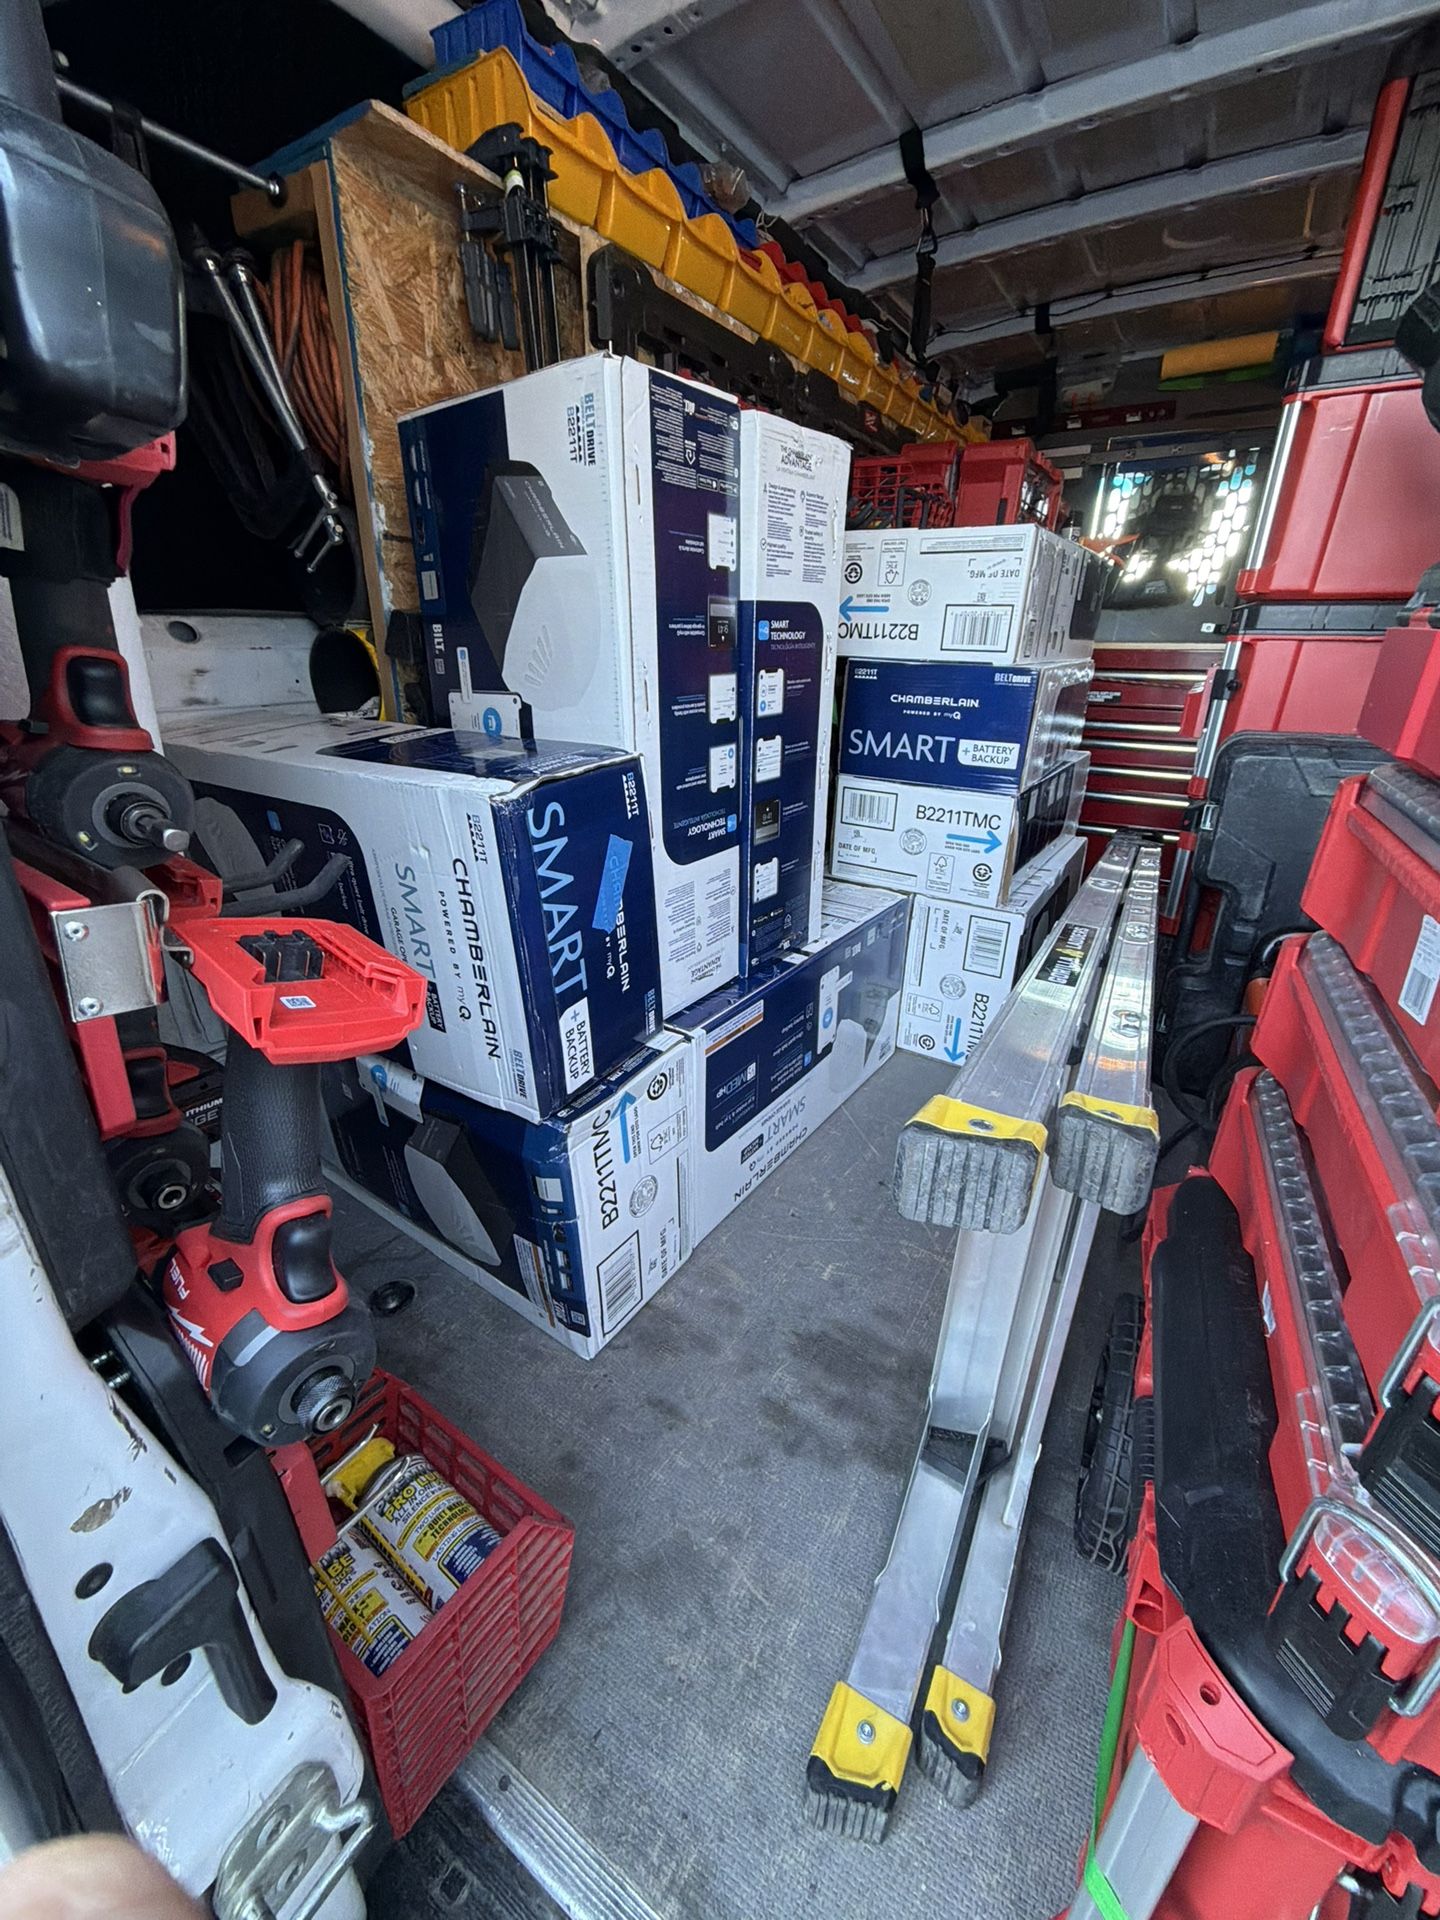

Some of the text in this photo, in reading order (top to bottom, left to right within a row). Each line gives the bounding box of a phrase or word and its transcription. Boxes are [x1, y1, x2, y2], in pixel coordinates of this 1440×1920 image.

[567, 406, 577, 463] B2211T
[1001, 569, 1020, 578] DATE
[770, 620, 790, 629] SMART
[770, 631, 806, 640] TECHNOLOGY
[890, 694, 980, 708] CHAMBERLAIN
[848, 728, 956, 764] SMART
[972, 744, 1015, 756] BATTERY
[972, 754, 1010, 766] BACKUP
[626, 772, 640, 816] B2211T
[688, 818, 726, 837] TECHNOLOGY
[708, 827, 726, 840] SMART
[916, 804, 1002, 831] B2211TMC
[470, 814, 488, 865] B2211T
[838, 842, 852, 851] DATE
[854, 844, 862, 852] OF
[528, 801, 588, 995] SMART
[390, 907, 406, 945] GARAGE
[394, 862, 436, 983] SMART
[438, 890, 457, 954] POWERED
[454, 964, 462, 979] BY
[942, 924, 948, 934] OF
[451, 856, 502, 1060] CHAMBERLAIN
[1047, 956, 1074, 984] GORILLA
[565, 1030, 581, 1081] BACKUP
[576, 1021, 591, 1077] BATTERY
[764, 1095, 806, 1144] SMART
[591, 1110, 620, 1230] B2211TMC
[734, 1126, 808, 1202] CHAMBERLAIN
[168, 1257, 190, 1300] FUEL
[384, 1485, 417, 1523] PRO
[394, 1506, 409, 1526] ALL
[428, 1508, 448, 1530] QUIET
[432, 1530, 458, 1562] LASTING
